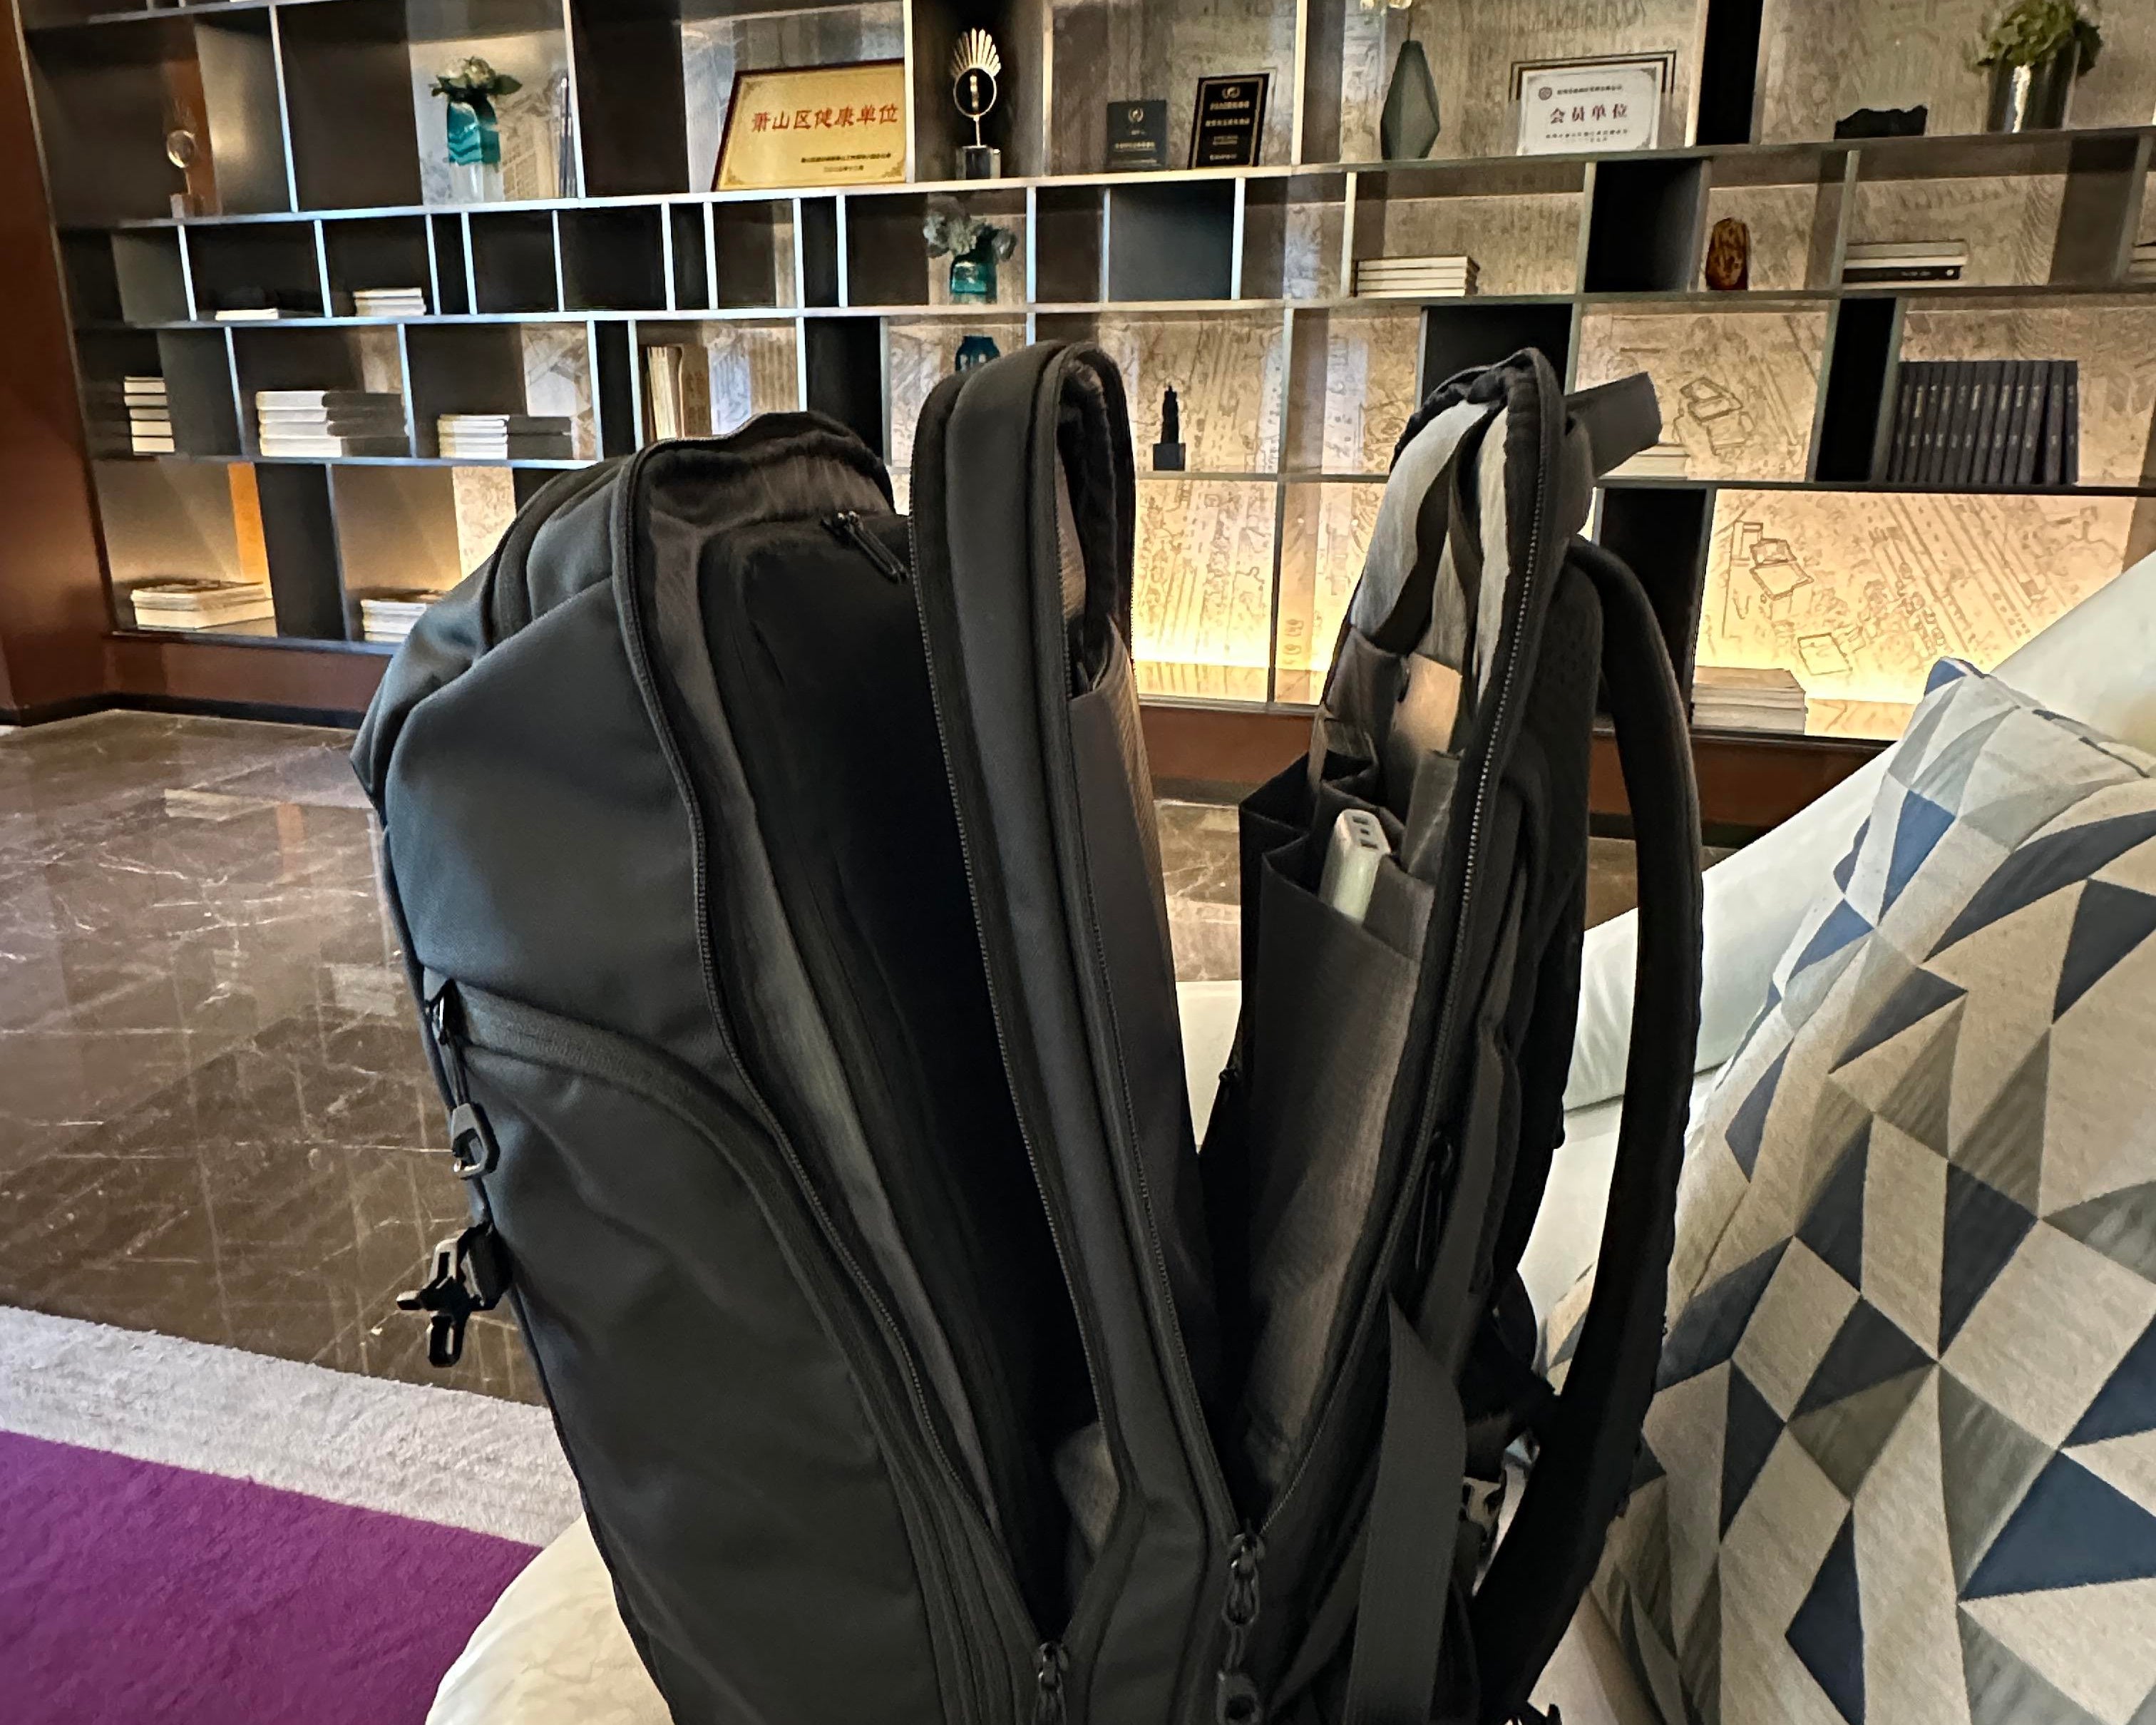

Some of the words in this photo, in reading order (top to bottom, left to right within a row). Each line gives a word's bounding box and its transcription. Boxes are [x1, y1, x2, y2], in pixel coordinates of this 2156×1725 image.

[751, 103, 898, 133] 萧山区健康单位
[1550, 103, 1628, 124] 会员单位
